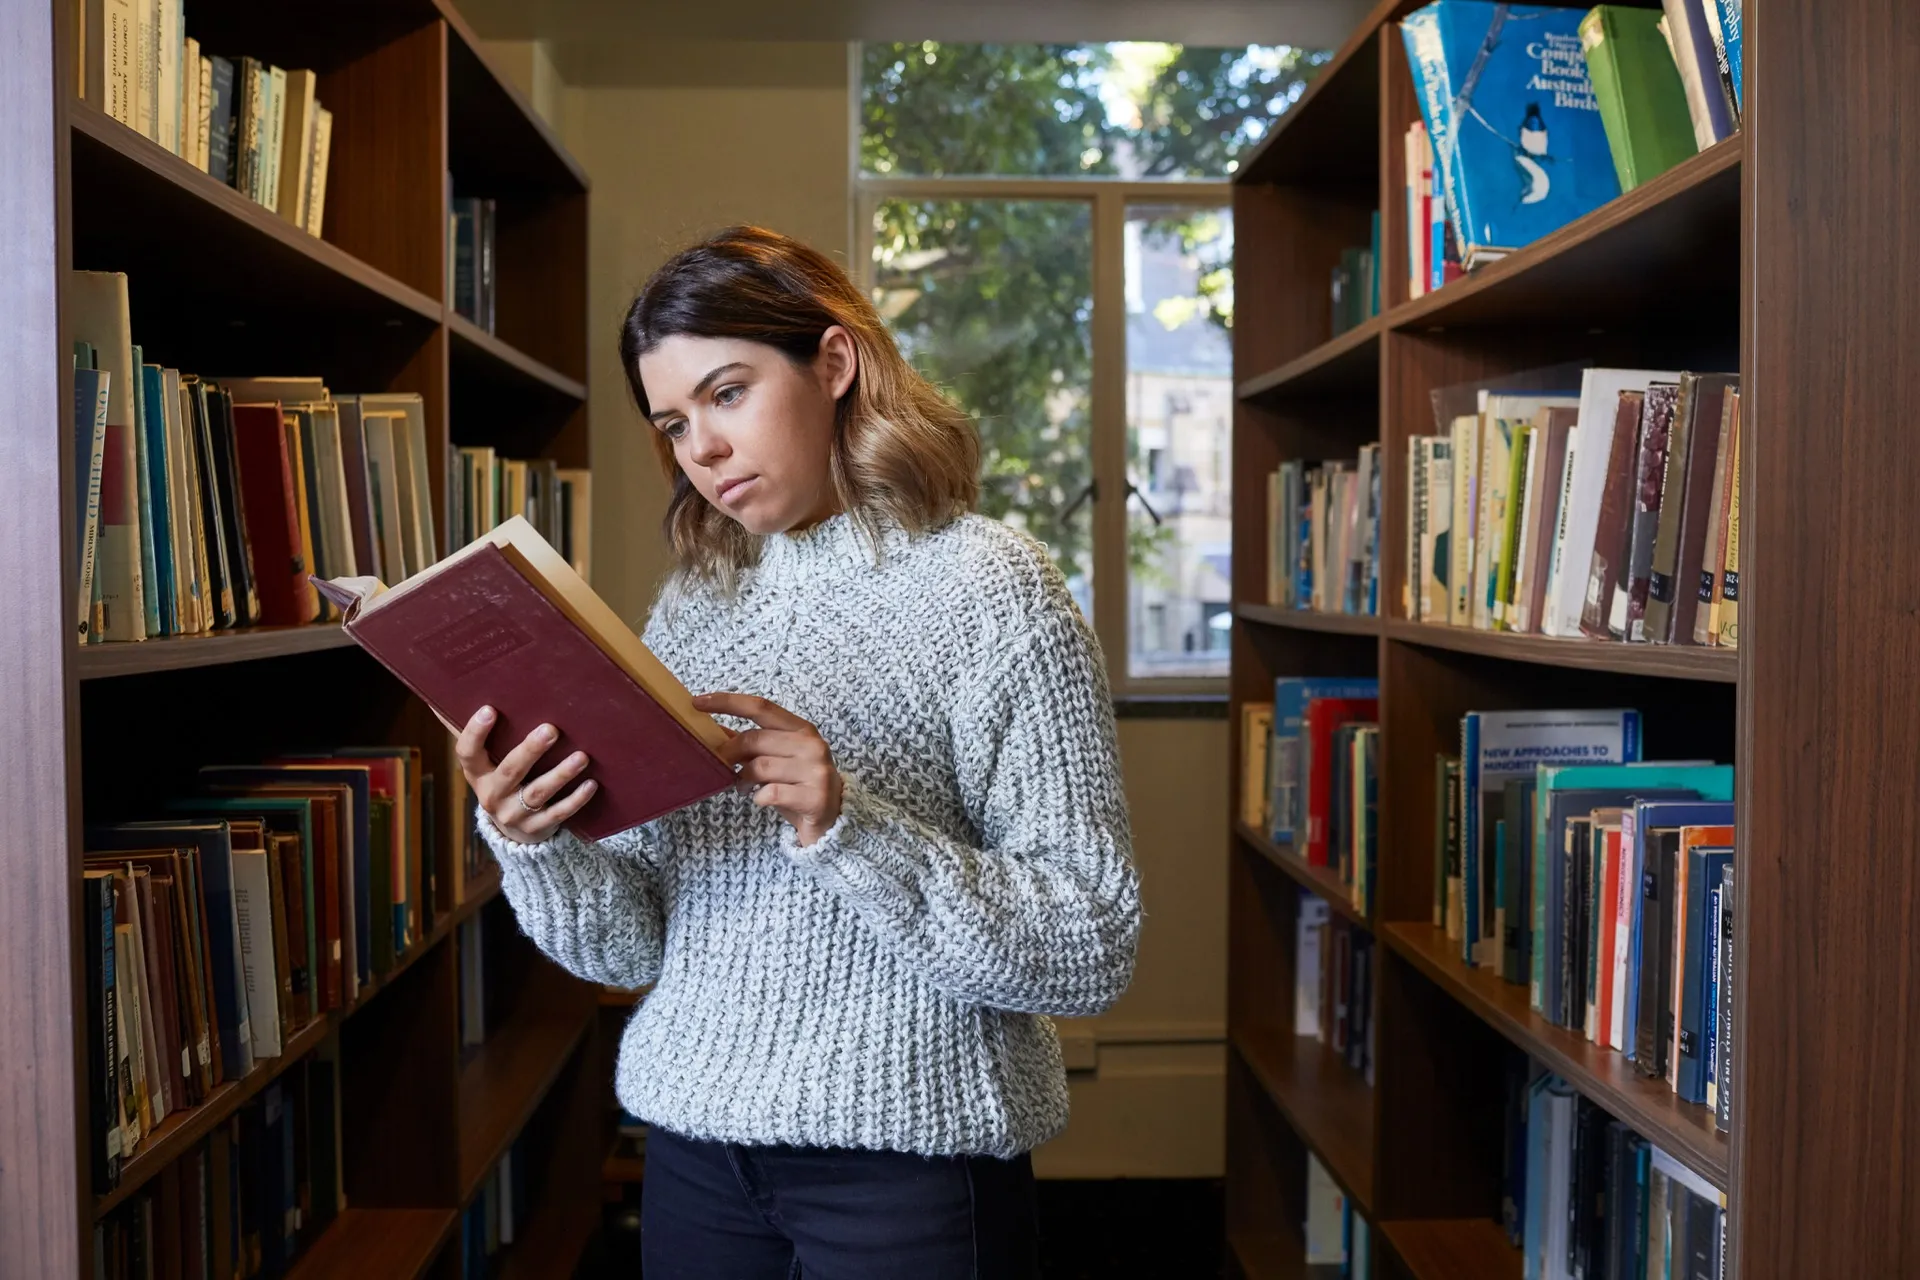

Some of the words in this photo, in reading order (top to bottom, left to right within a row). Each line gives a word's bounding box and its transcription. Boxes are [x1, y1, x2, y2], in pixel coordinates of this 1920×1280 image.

[1720, 0, 1740, 43] raphy
[1555, 91, 1600, 111] Birds
[95, 389, 108, 442] ONLY
[88, 452, 102, 520] CHILD
[86, 524, 95, 559] MIRIAM
[1484, 747, 1510, 758] NEW
[1514, 746, 1589, 757] APPROACHES
[1593, 746, 1608, 756] TO
[106, 991, 114, 1032] MICHAEL
